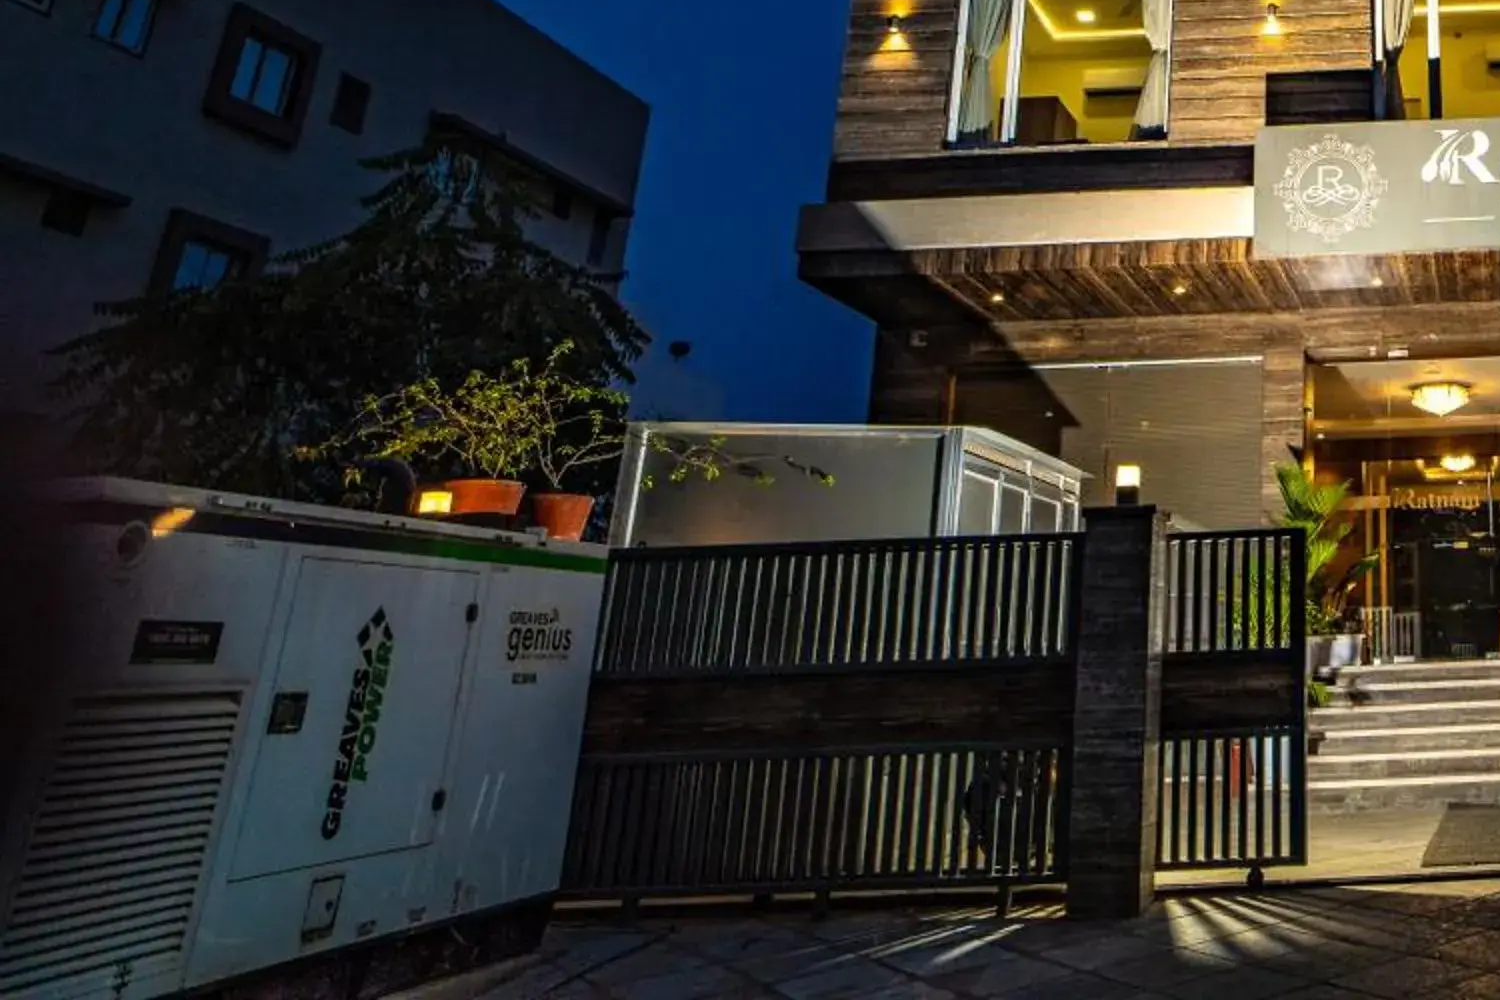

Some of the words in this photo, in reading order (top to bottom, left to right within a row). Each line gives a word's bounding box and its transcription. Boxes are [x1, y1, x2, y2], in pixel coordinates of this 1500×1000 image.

[351, 640, 395, 782] POWER
[505, 625, 573, 662] genius
[321, 668, 371, 840] GREAVES
